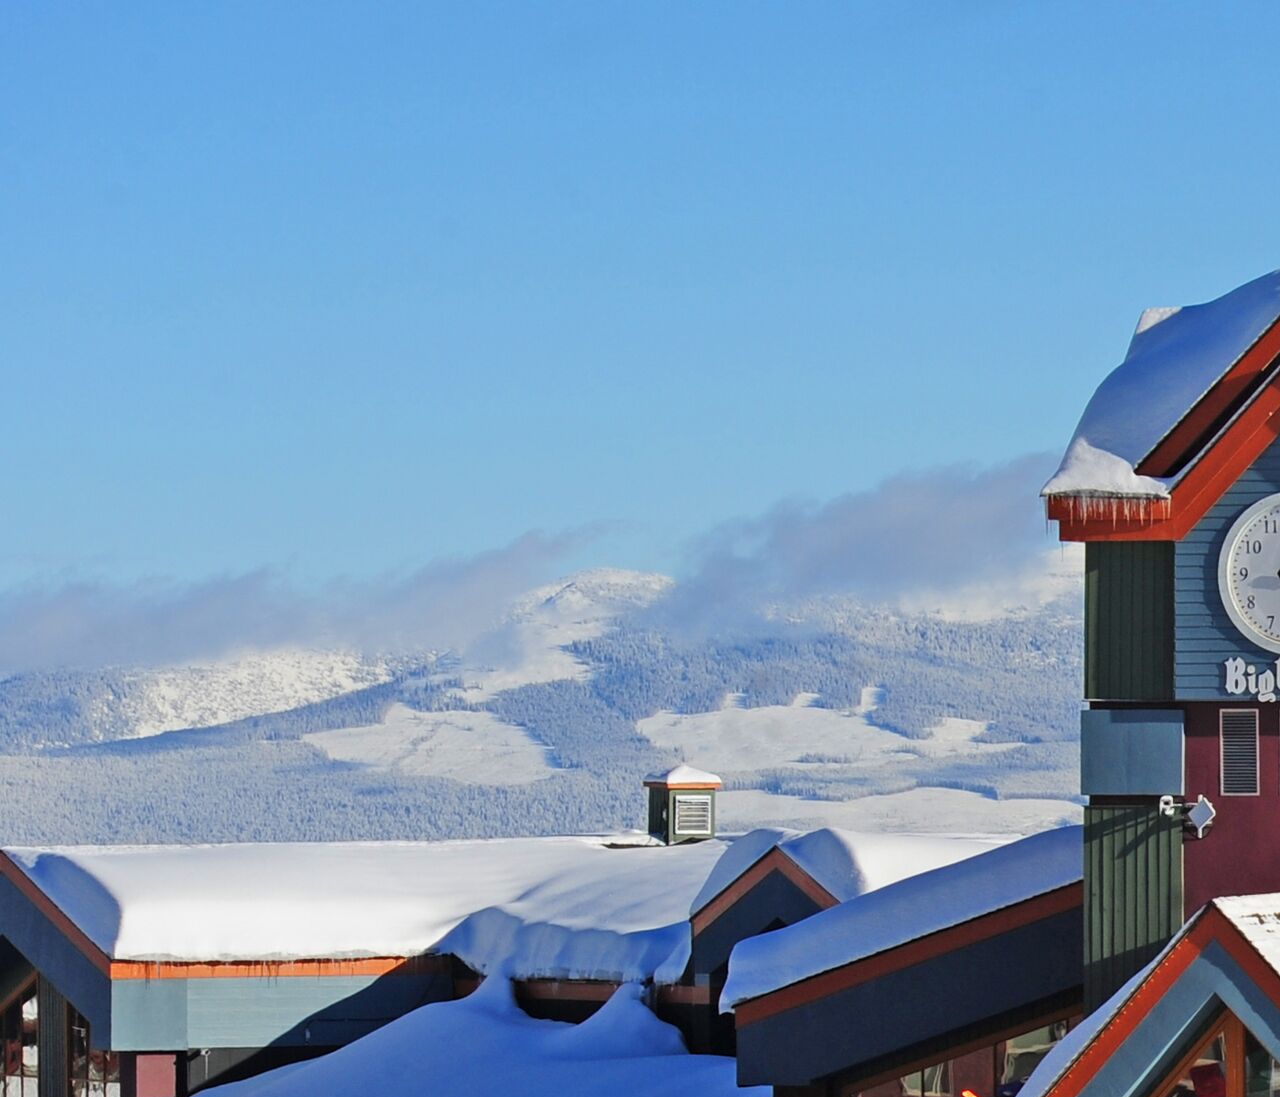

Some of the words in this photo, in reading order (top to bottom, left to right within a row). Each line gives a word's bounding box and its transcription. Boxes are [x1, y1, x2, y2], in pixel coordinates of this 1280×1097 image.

[1264, 519, 1278, 534] 11
[1245, 540, 1262, 554] 10
[1239, 567, 1249, 581] 9
[1247, 595, 1256, 609] 8
[1266, 615, 1275, 630] 7
